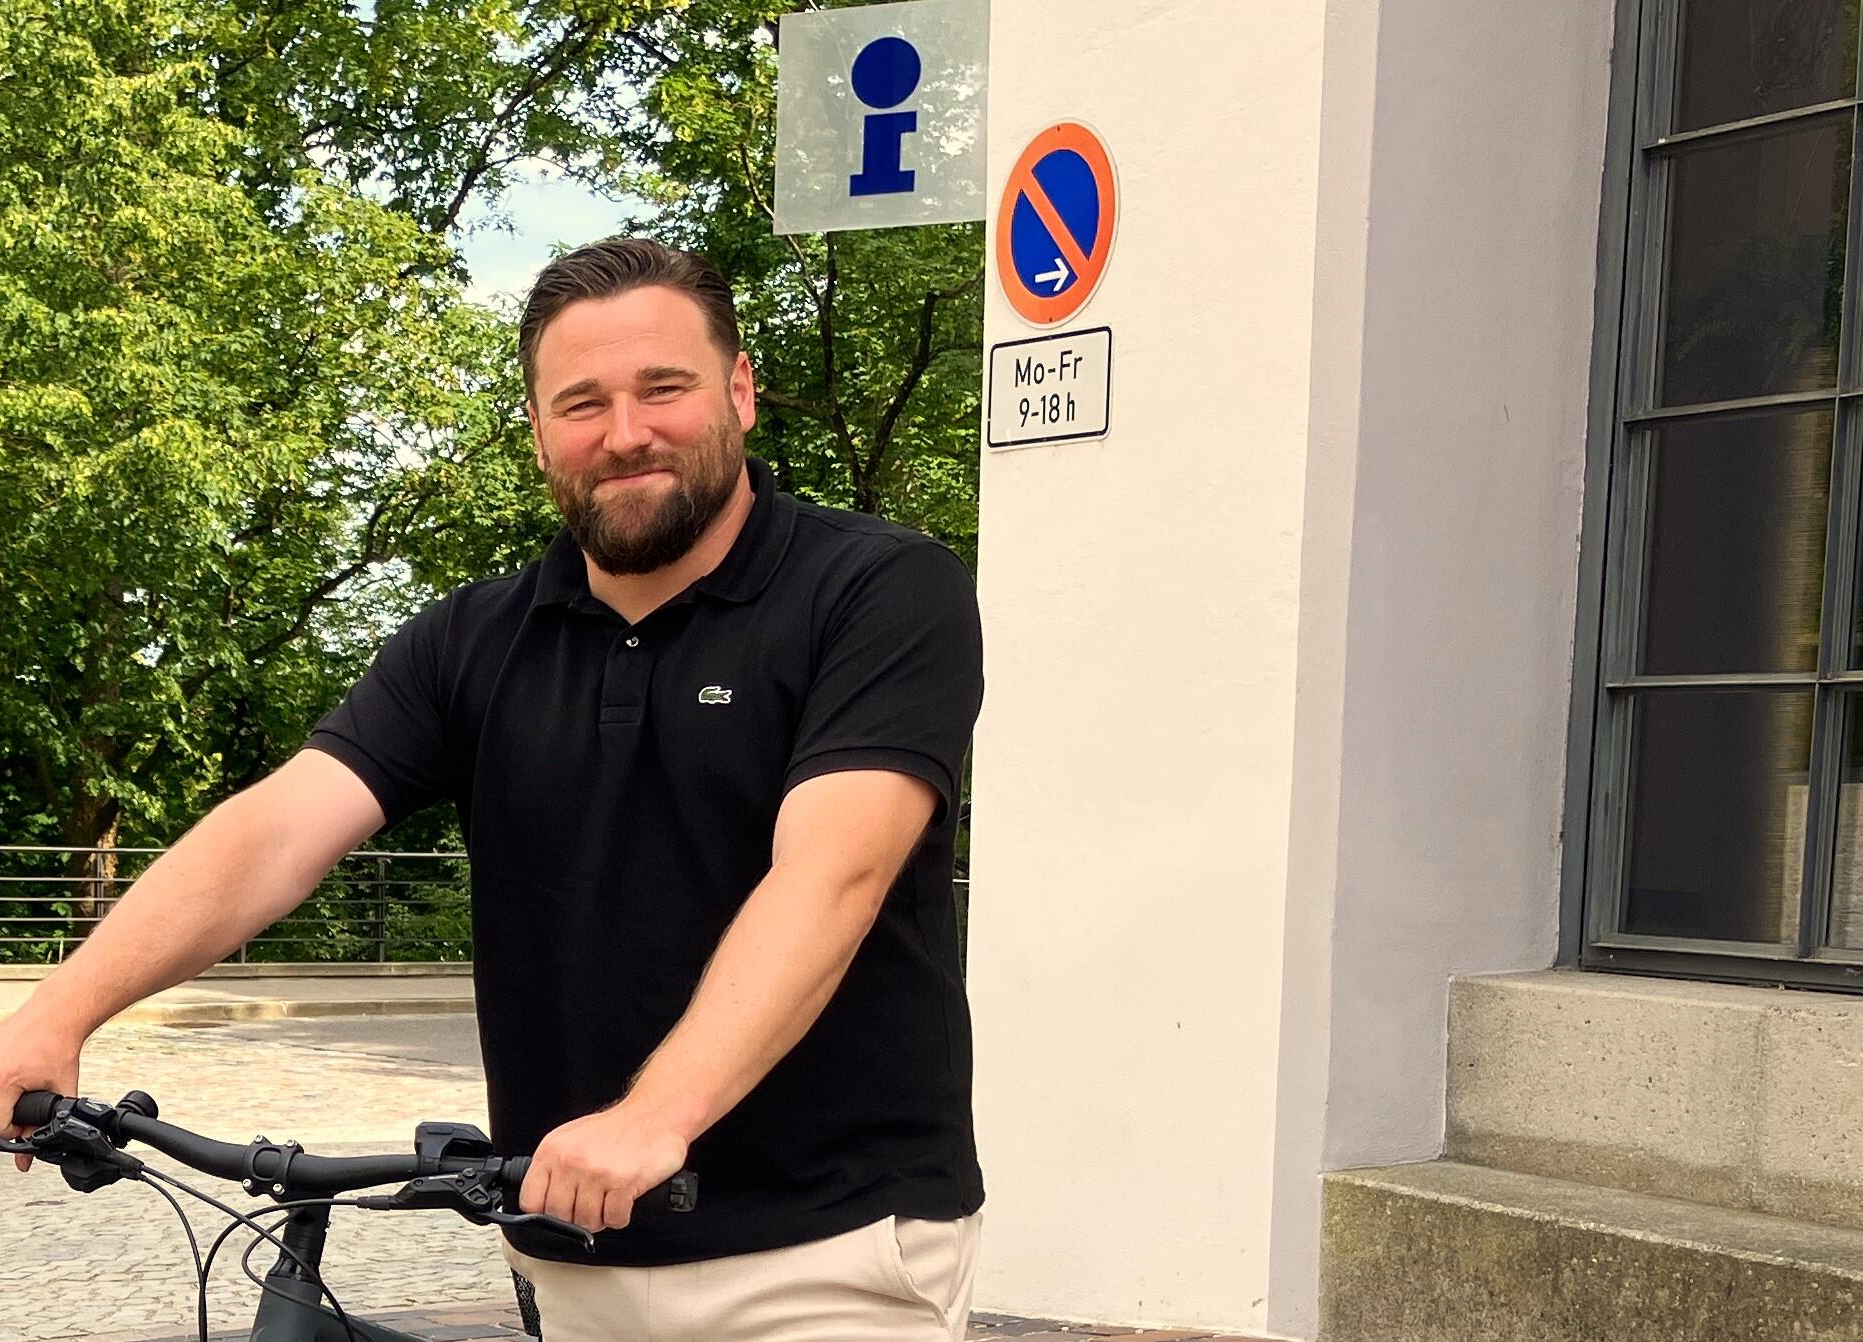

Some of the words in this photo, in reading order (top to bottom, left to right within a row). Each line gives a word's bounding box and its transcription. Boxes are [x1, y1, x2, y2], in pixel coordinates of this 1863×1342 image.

[1015, 350, 1083, 388] Mo-Fr
[1019, 393, 1060, 428] 9-18
[1067, 391, 1075, 421] h
